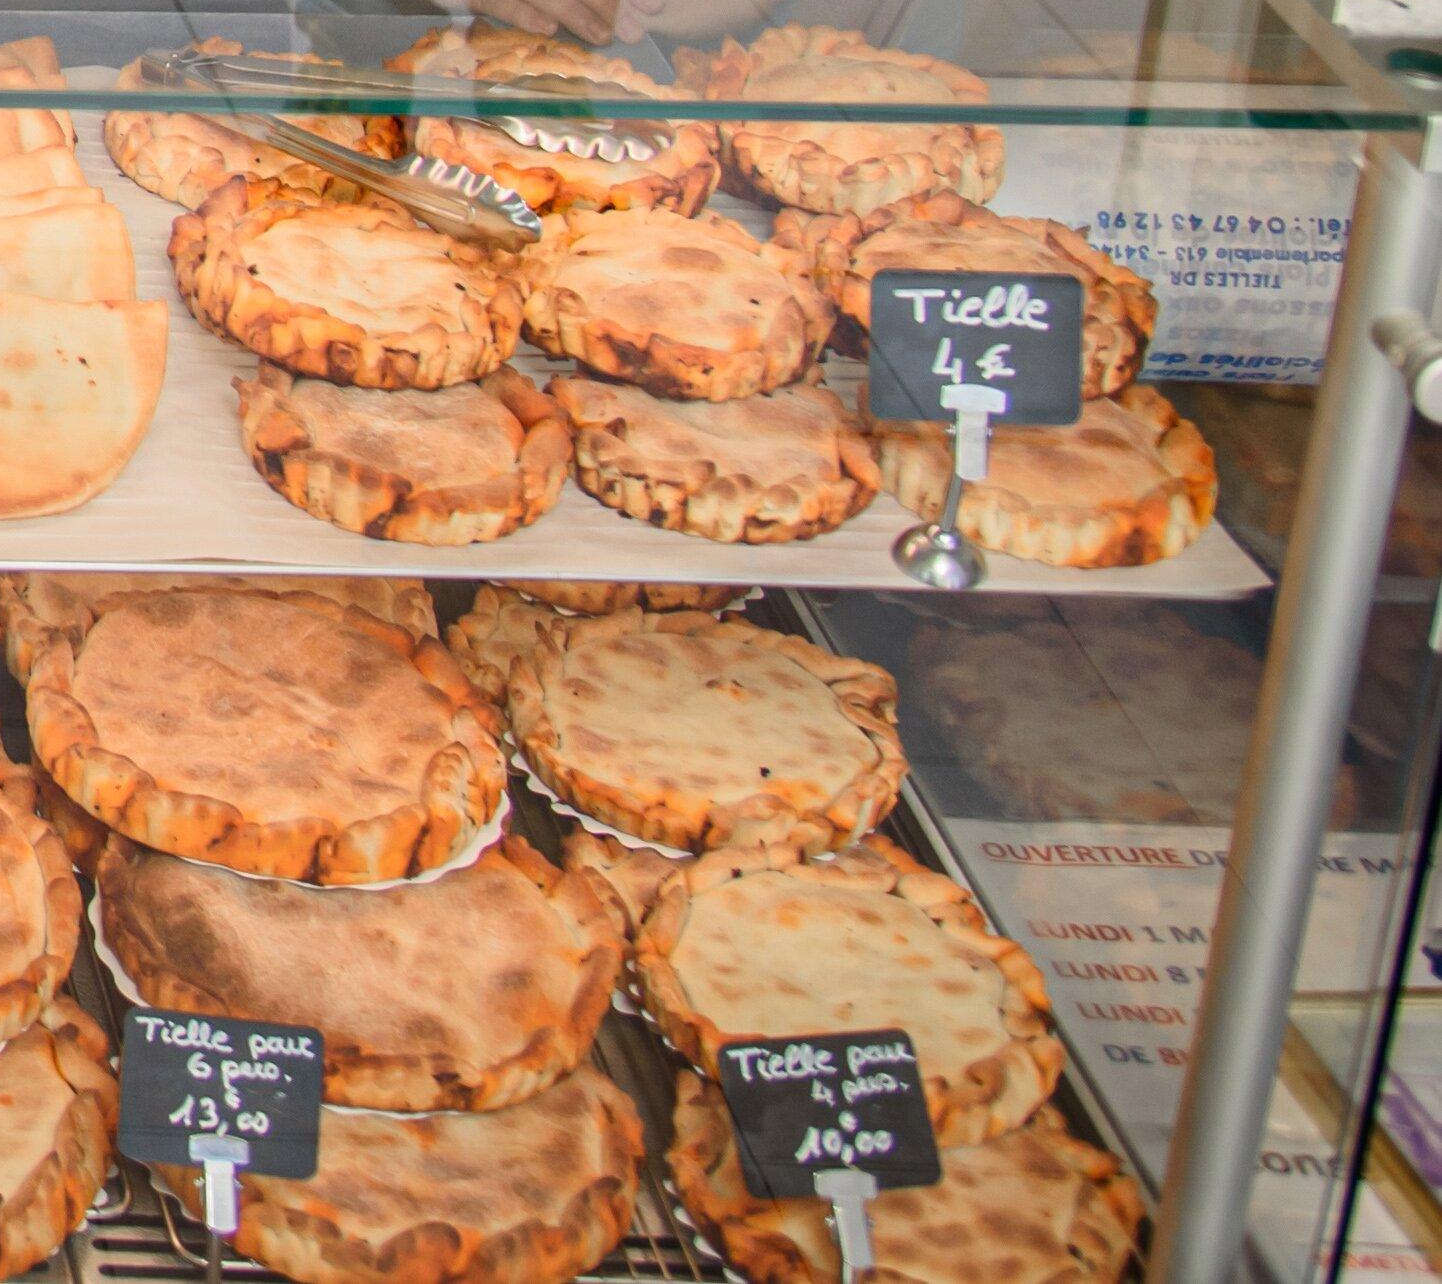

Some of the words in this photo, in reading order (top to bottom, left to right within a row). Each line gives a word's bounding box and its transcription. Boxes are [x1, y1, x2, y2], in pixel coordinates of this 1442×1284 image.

[1214, 246, 1344, 264] partementale
[1204, 271, 1281, 290] TIELLES
[892, 283, 1050, 331] Tielle
[980, 841, 1186, 866] OUVERTURE
[1025, 917, 1136, 944] LUNDI
[1050, 959, 1160, 984] LUNDI
[1075, 1001, 1189, 1027] LUNDI
[134, 1014, 234, 1054] Tielle
[247, 1033, 316, 1061] pour
[186, 1051, 213, 1080] 6
[725, 1042, 838, 1082] Tielle
[846, 1042, 918, 1077] pour
[810, 1078, 837, 1107] 4
